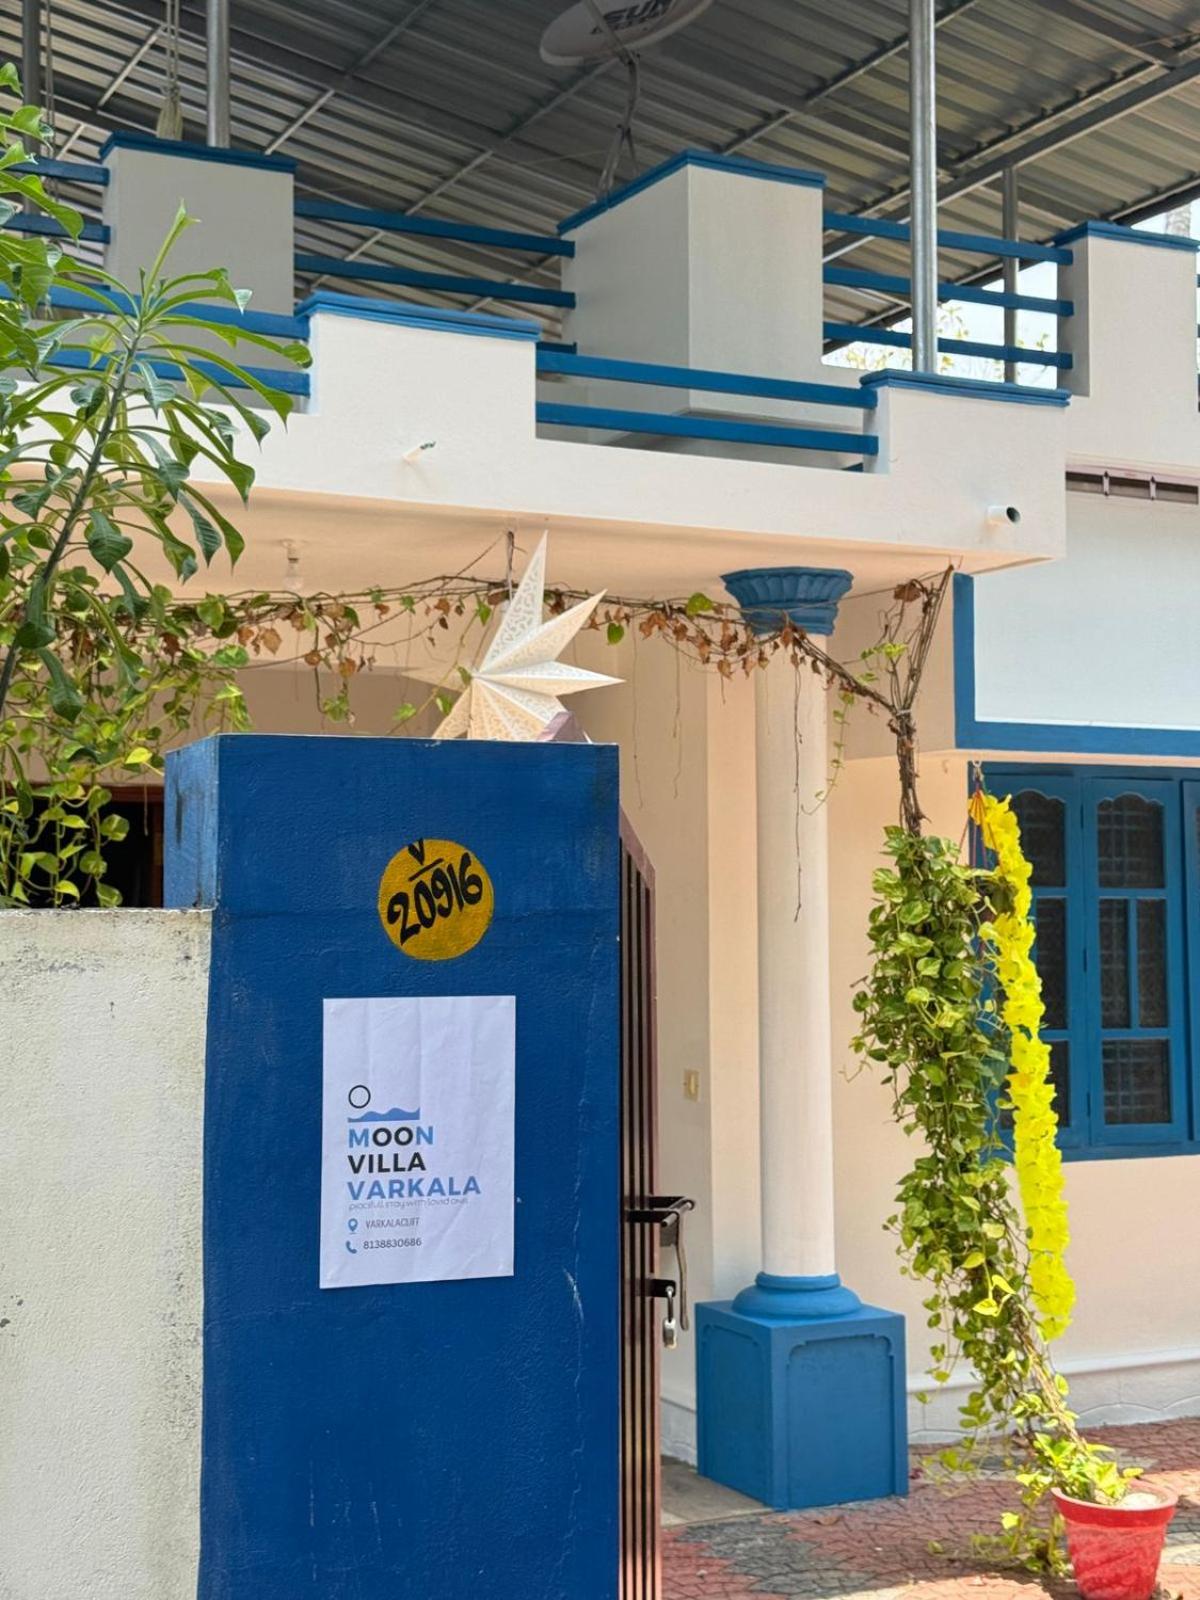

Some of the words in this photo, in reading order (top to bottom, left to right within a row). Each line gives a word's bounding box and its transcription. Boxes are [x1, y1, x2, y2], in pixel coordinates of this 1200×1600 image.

[387, 852, 483, 946] 20916
[348, 1126, 434, 1149] MOON
[347, 1152, 427, 1174] VILLA
[347, 1175, 481, 1201] VARKALA
[363, 1238, 422, 1250] 8138830686
